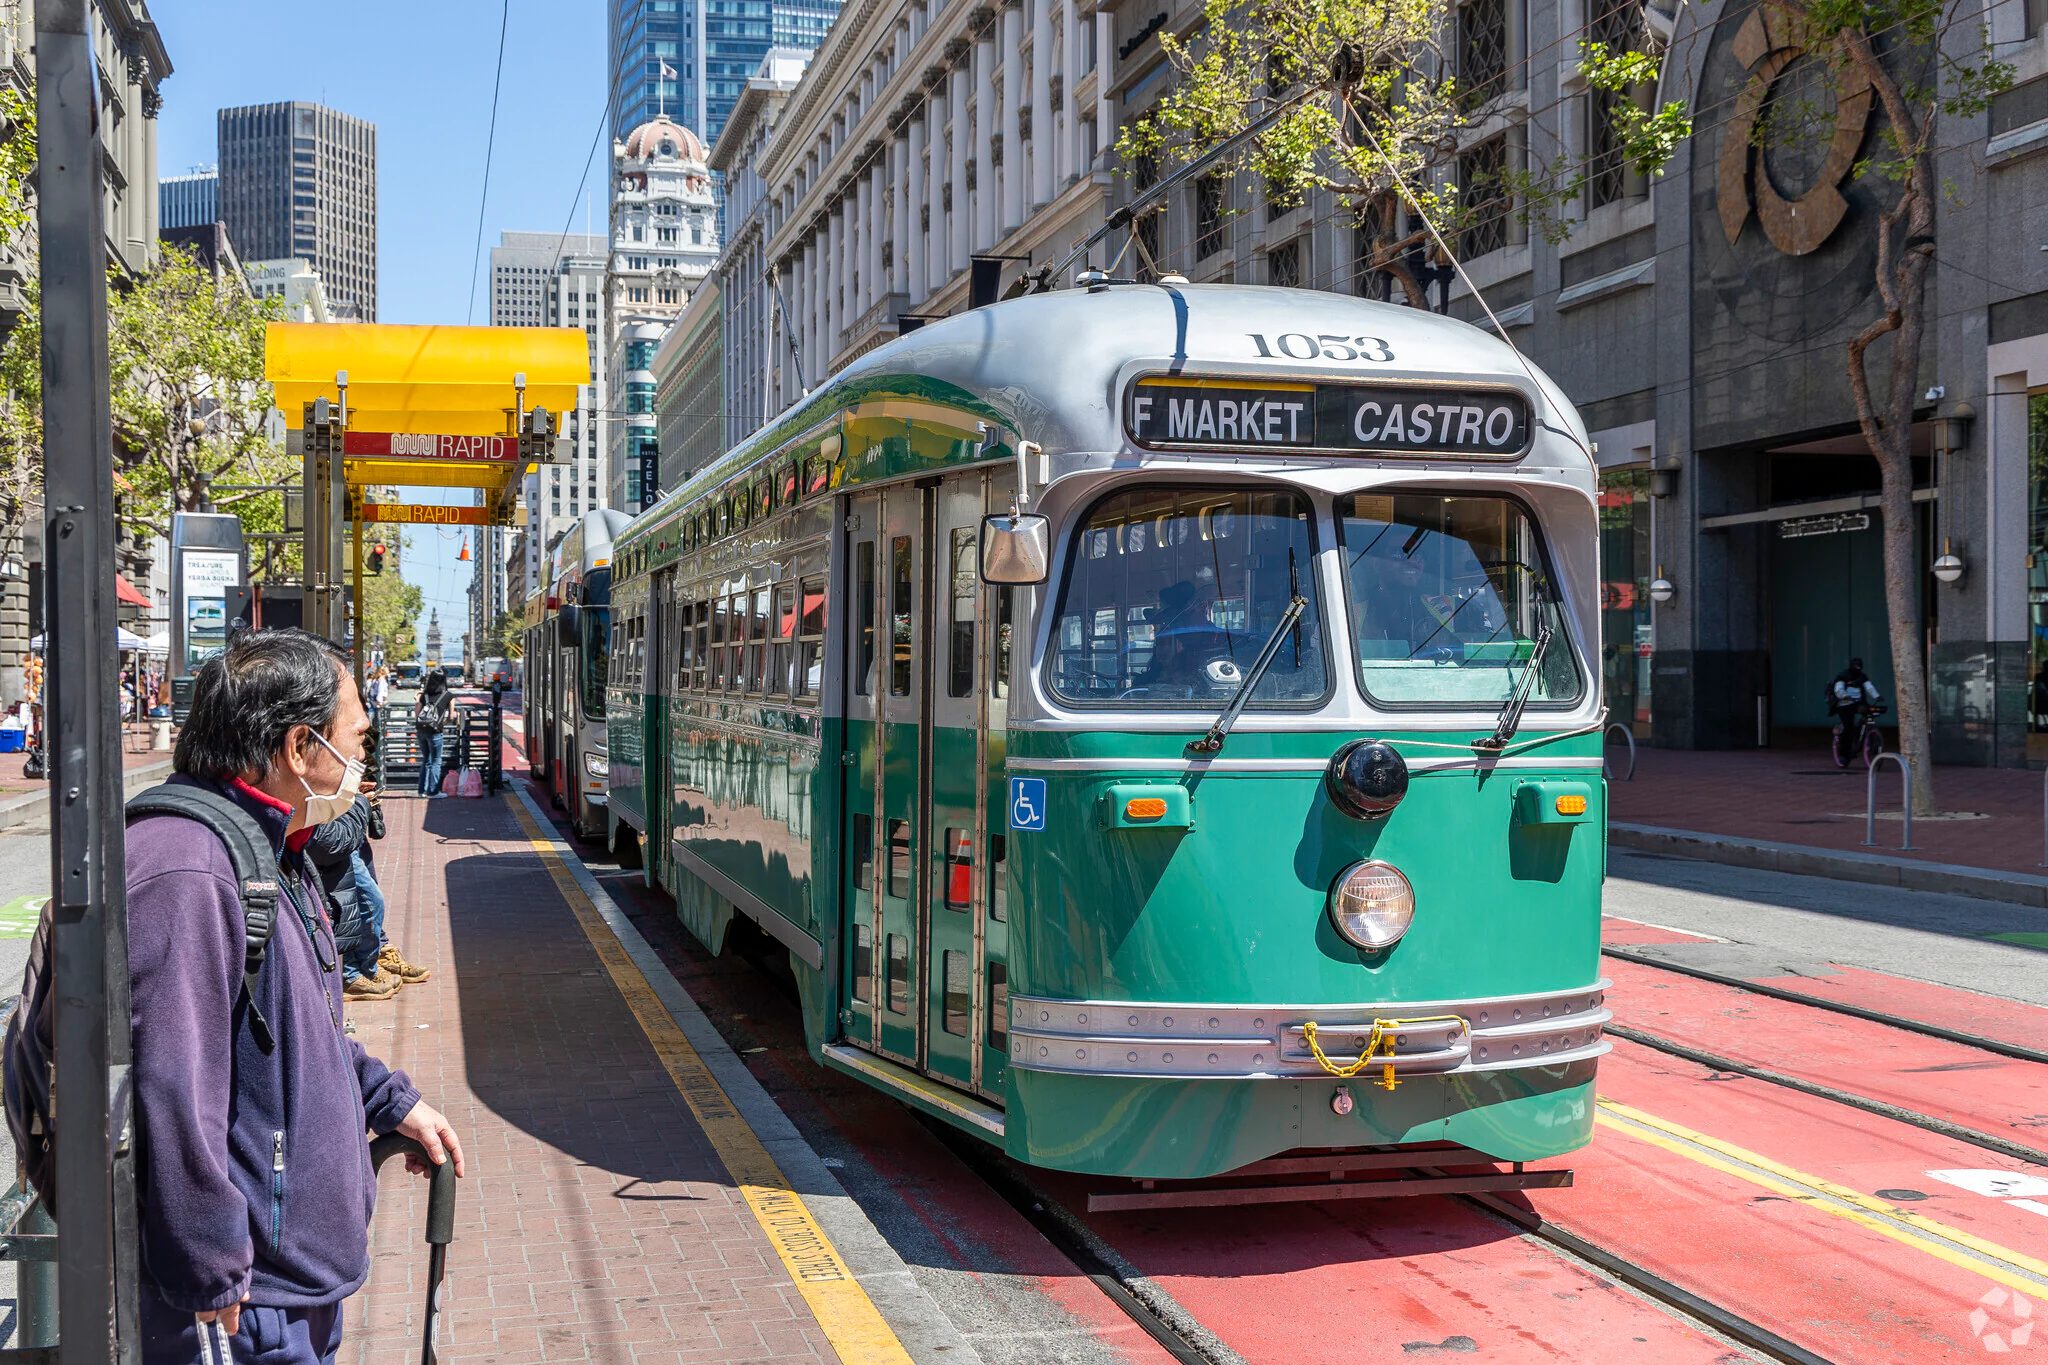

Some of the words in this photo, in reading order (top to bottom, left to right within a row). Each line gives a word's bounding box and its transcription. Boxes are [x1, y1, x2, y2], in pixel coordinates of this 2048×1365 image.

[1245, 333, 1395, 362] 1053
[1134, 397, 1153, 438] F
[1168, 398, 1304, 442] MARKET
[1354, 401, 1514, 446] CASTRO
[440, 435, 505, 459] RAPID
[413, 506, 460, 524] RAPID
[776, 1228, 825, 1251] CROSS
[791, 1254, 845, 1282] STREET
